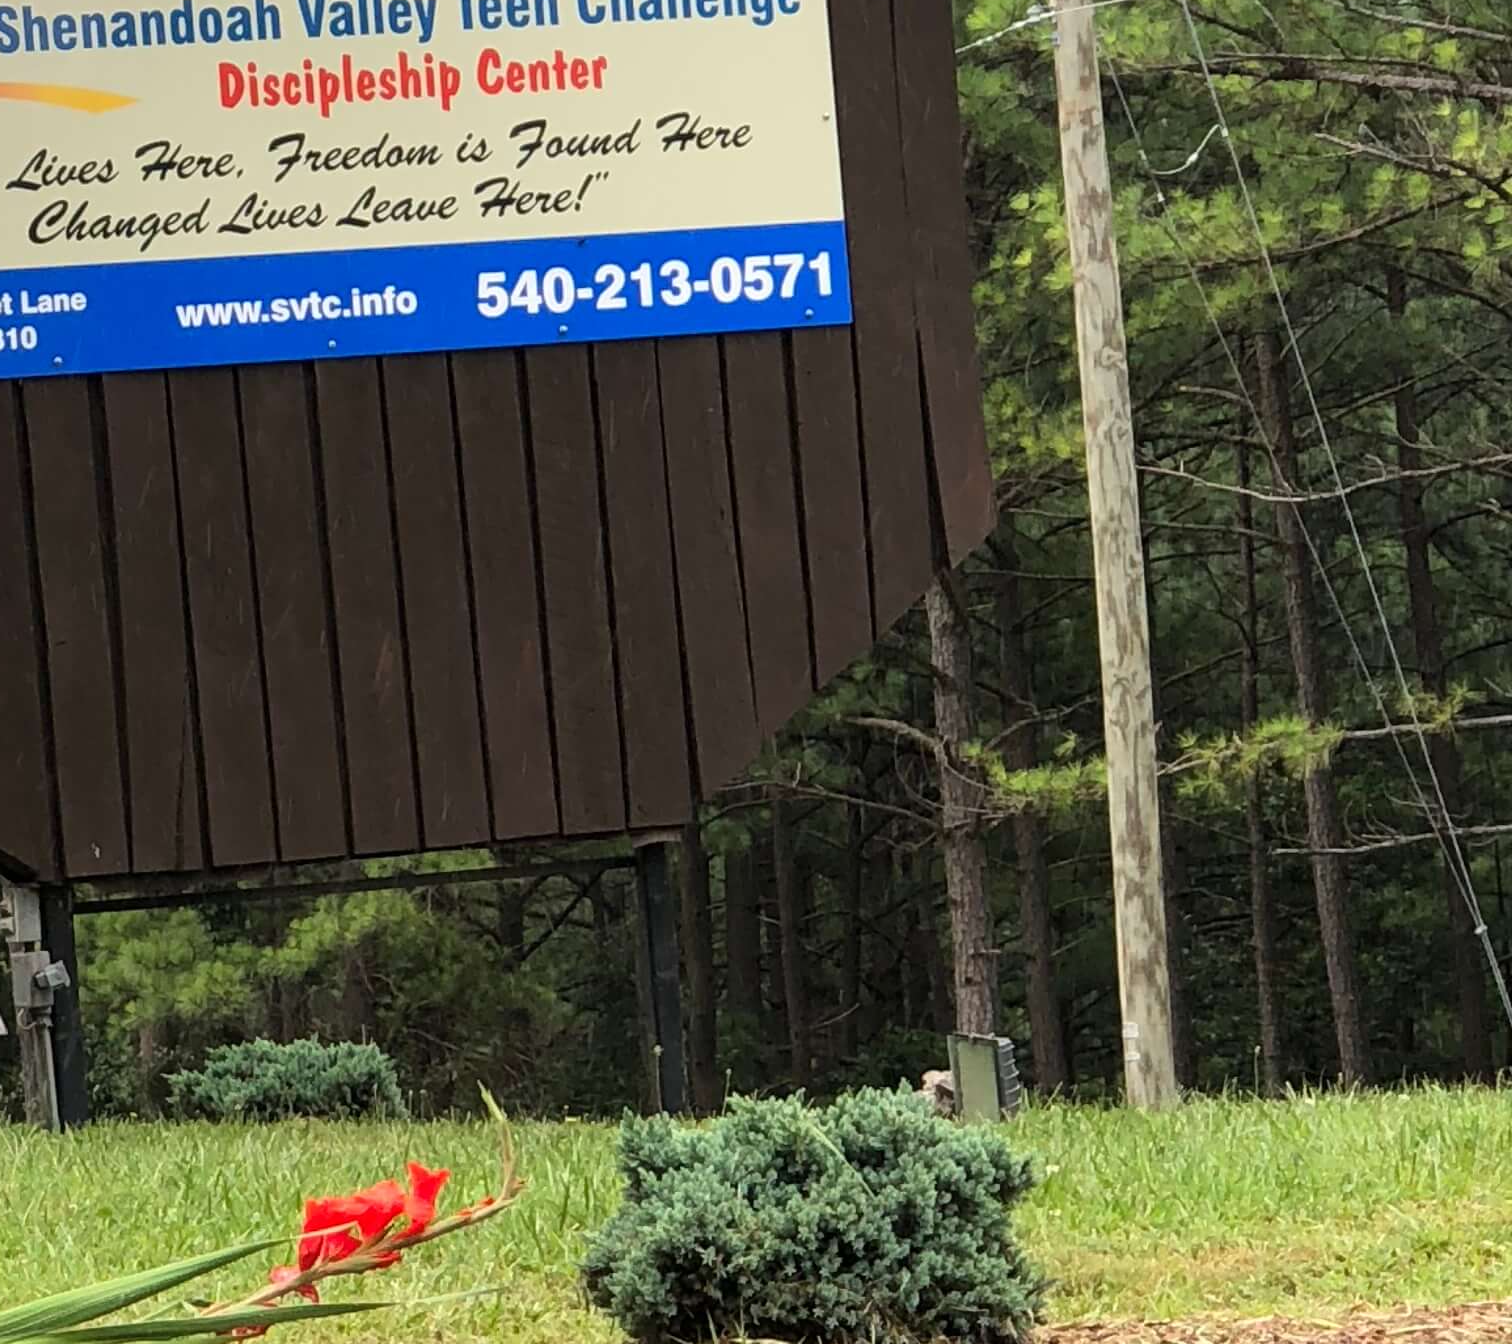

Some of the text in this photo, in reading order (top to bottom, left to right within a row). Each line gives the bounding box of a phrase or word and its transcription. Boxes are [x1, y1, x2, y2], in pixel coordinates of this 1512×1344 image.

[218, 47, 608, 119] Discipleship Center
[5, 148, 119, 192] Lives
[267, 132, 442, 183] Freedom
[457, 131, 492, 163] is
[508, 118, 641, 169] Found
[654, 111, 754, 153] Here
[27, 197, 211, 253] Changed
[217, 192, 328, 235] Lives
[336, 185, 458, 229] Leave
[20, 289, 88, 316] Lane
[176, 285, 418, 328] www.svtc.info
[476, 252, 834, 319] 540-213-0571
